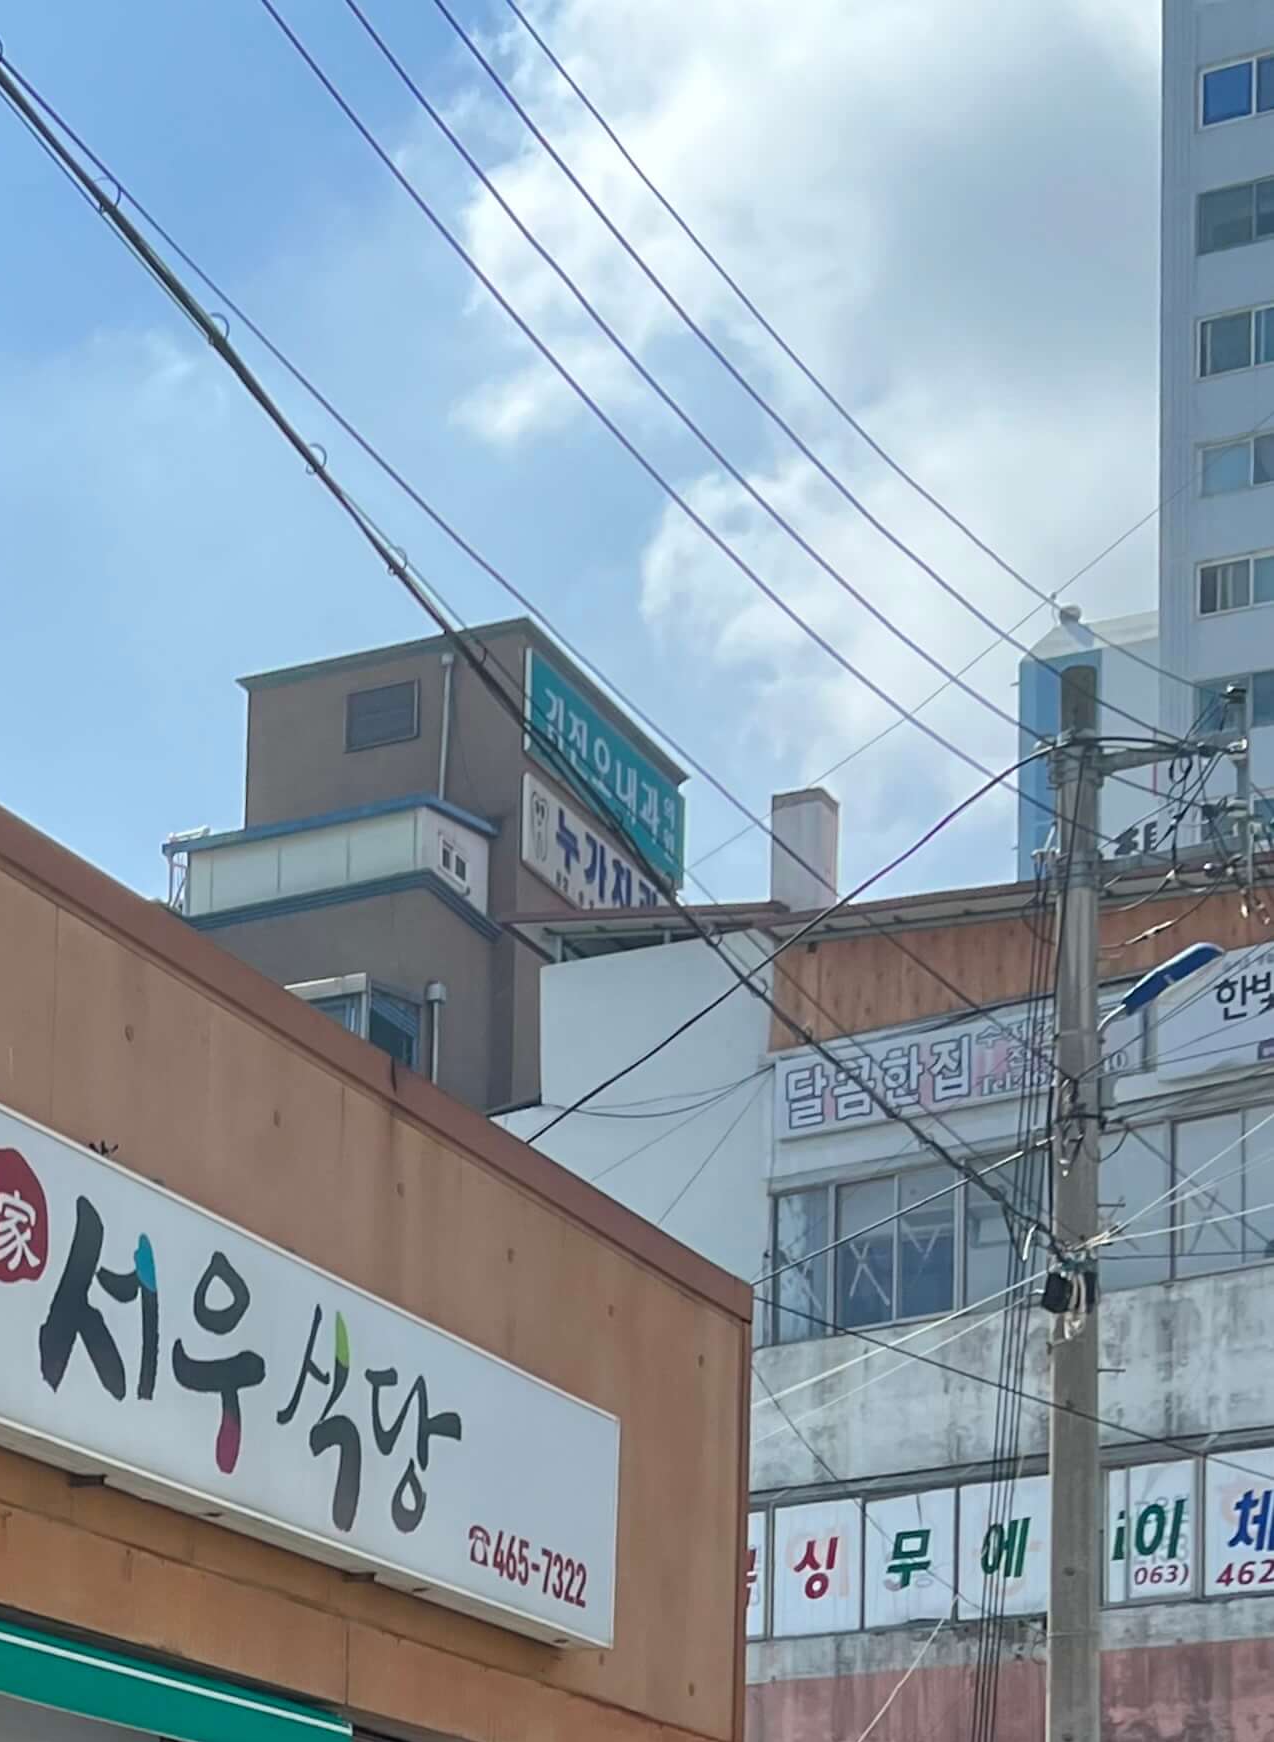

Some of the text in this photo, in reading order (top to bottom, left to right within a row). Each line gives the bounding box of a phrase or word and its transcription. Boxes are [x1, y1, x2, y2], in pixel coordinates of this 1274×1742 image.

[786, 1033, 972, 1129] 달콤한집
[39, 1196, 462, 1533] 서우식당
[492, 1530, 587, 1609] 465-7322
[1134, 1564, 1189, 1586] 063)
